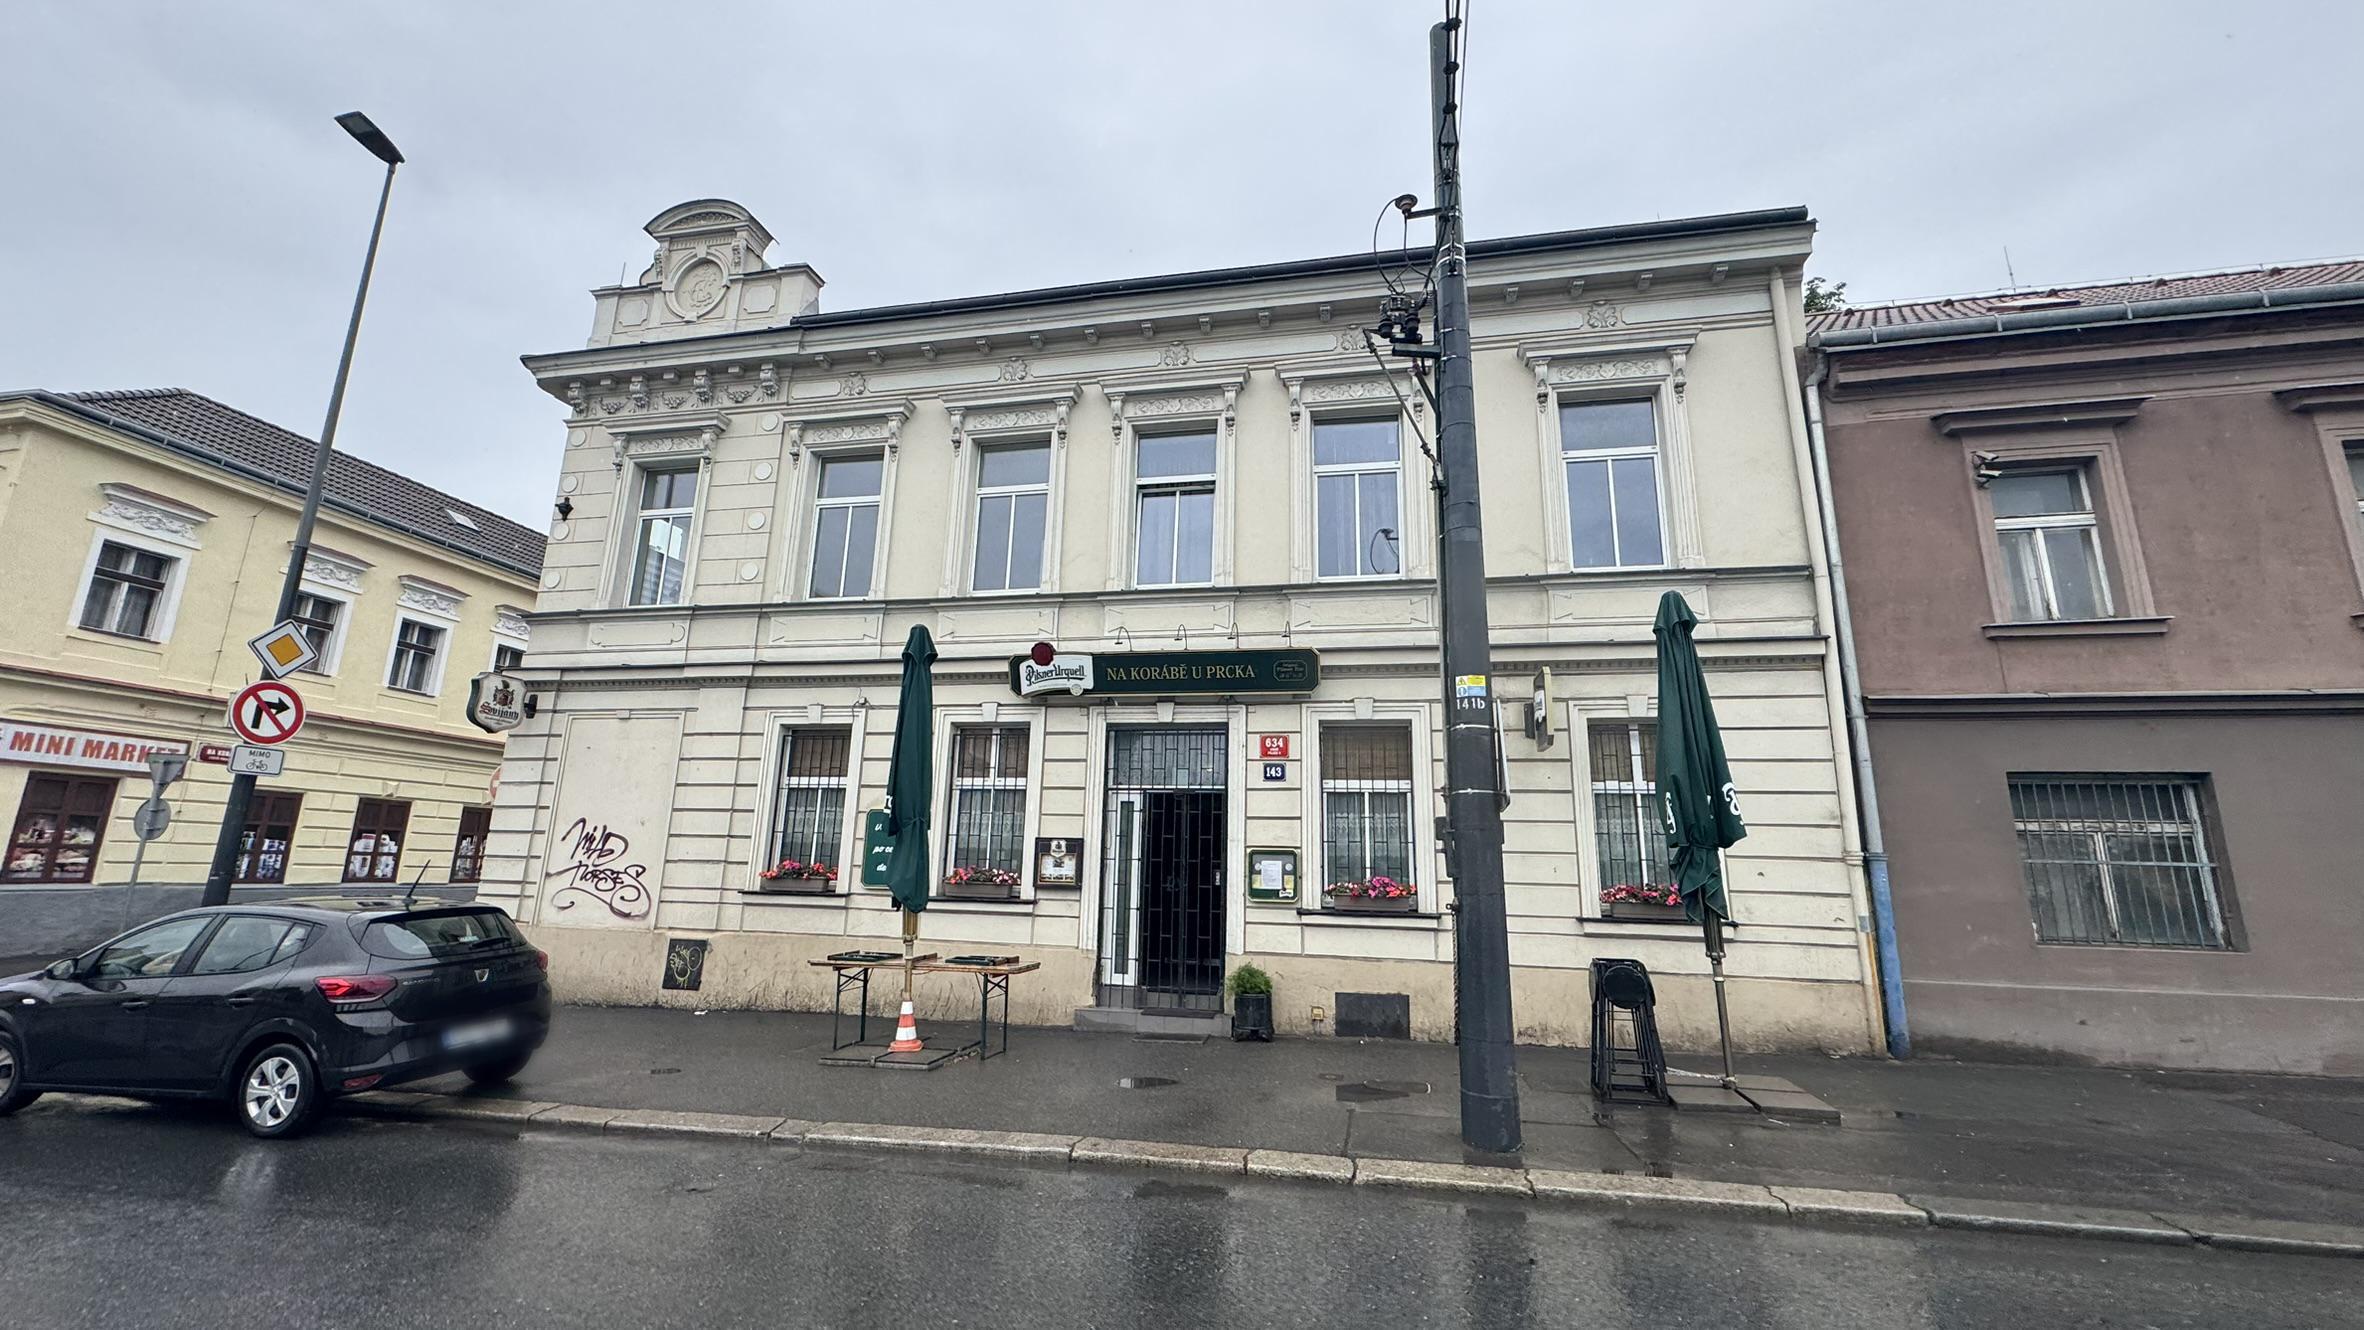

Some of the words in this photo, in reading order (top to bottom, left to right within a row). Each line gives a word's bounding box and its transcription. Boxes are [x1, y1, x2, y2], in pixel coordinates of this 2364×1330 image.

[1025, 665, 1053, 686] Pilsner
[1053, 664, 1084, 681] Urquell
[1107, 667, 1126, 680] NA
[1131, 664, 1188, 680] KORÁBĚ
[1192, 666, 1202, 679] U
[1207, 664, 1256, 679] PRCKA
[1456, 697, 1485, 710] 141b
[9, 731, 76, 756] MINI
[81, 738, 180, 763] MARK
[1265, 737, 1283, 748] 634
[249, 750, 271, 758] MIMO
[1266, 766, 1282, 777] 143
